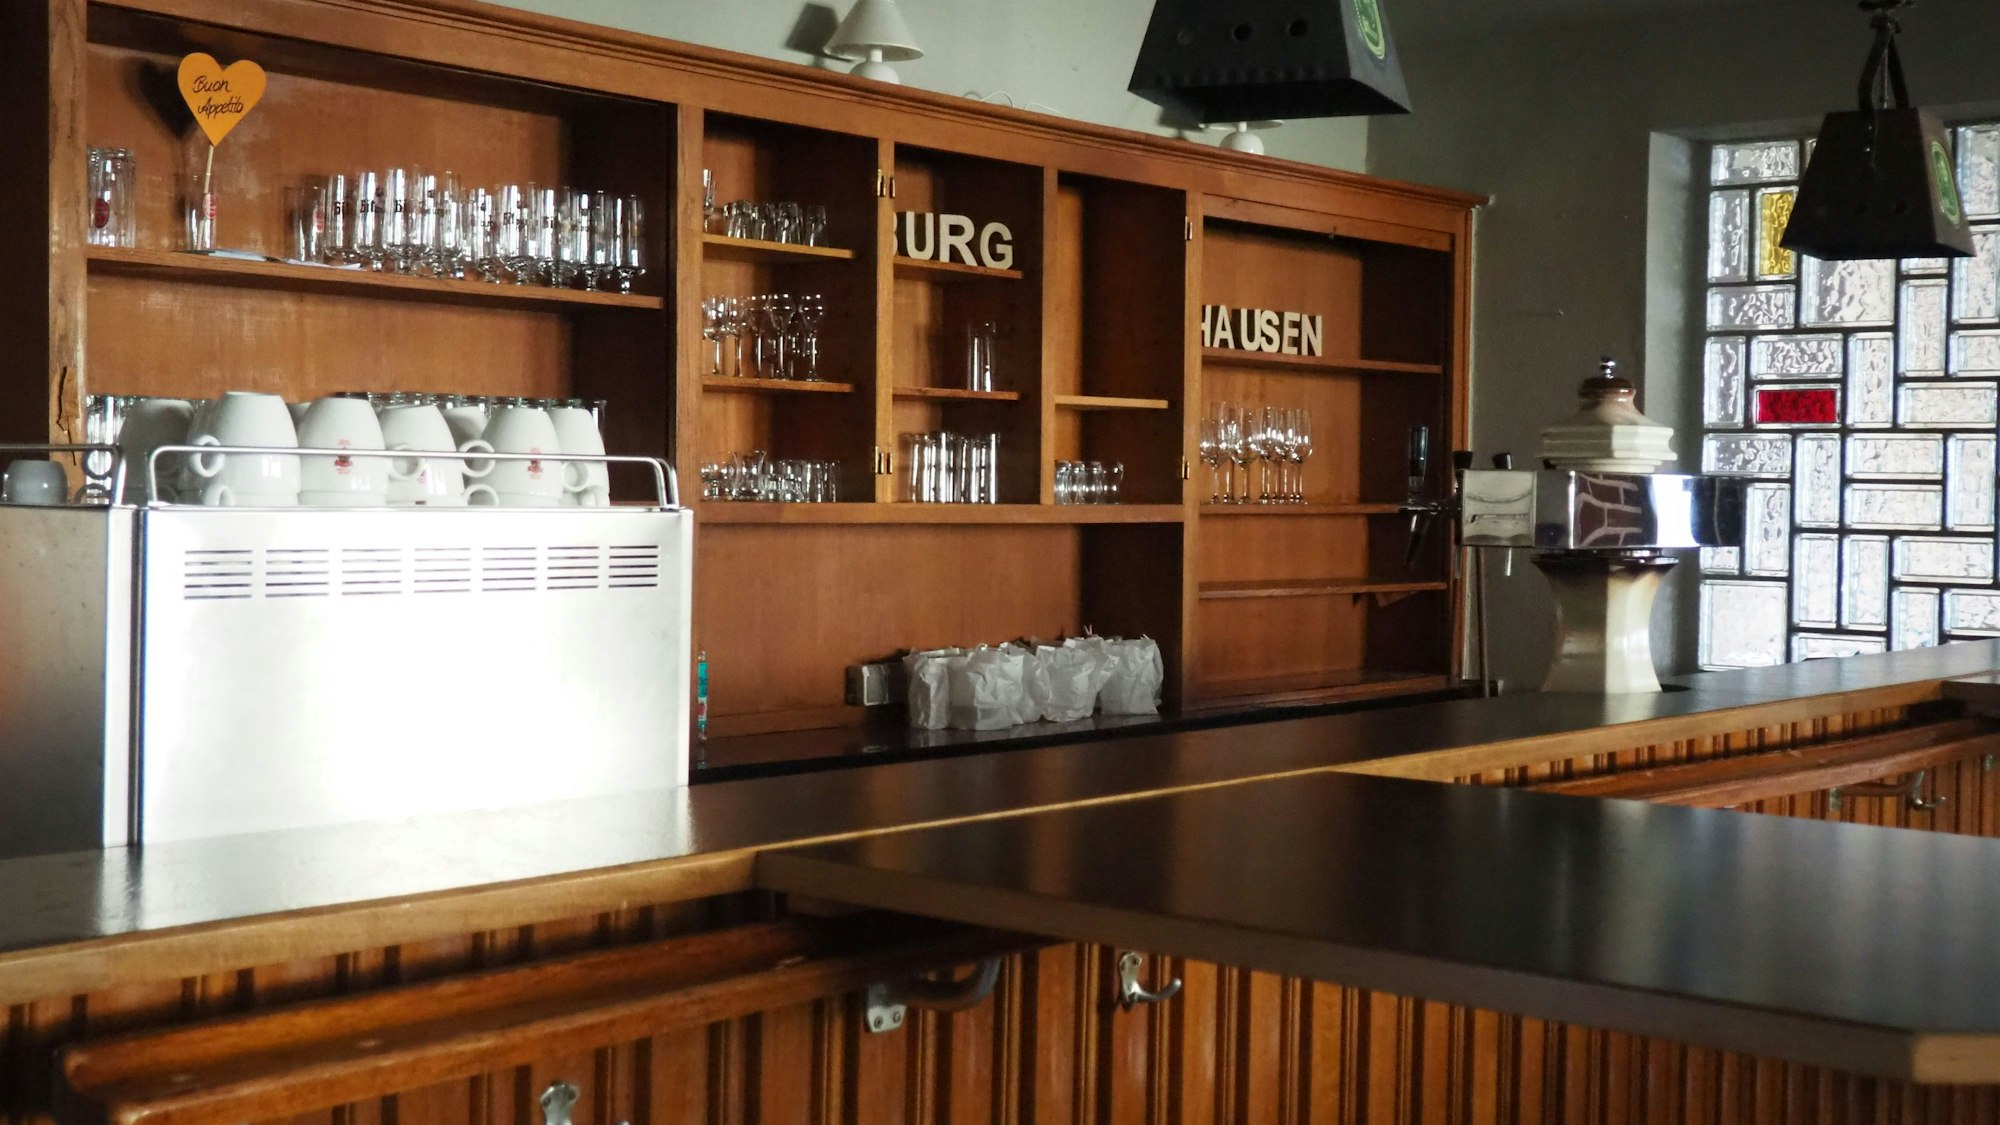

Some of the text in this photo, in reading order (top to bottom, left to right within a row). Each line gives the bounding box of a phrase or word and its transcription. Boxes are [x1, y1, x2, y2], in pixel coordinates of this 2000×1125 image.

[192, 75, 232, 94] Buon
[197, 96, 244, 119] Appetito
[893, 210, 1014, 270] URG
